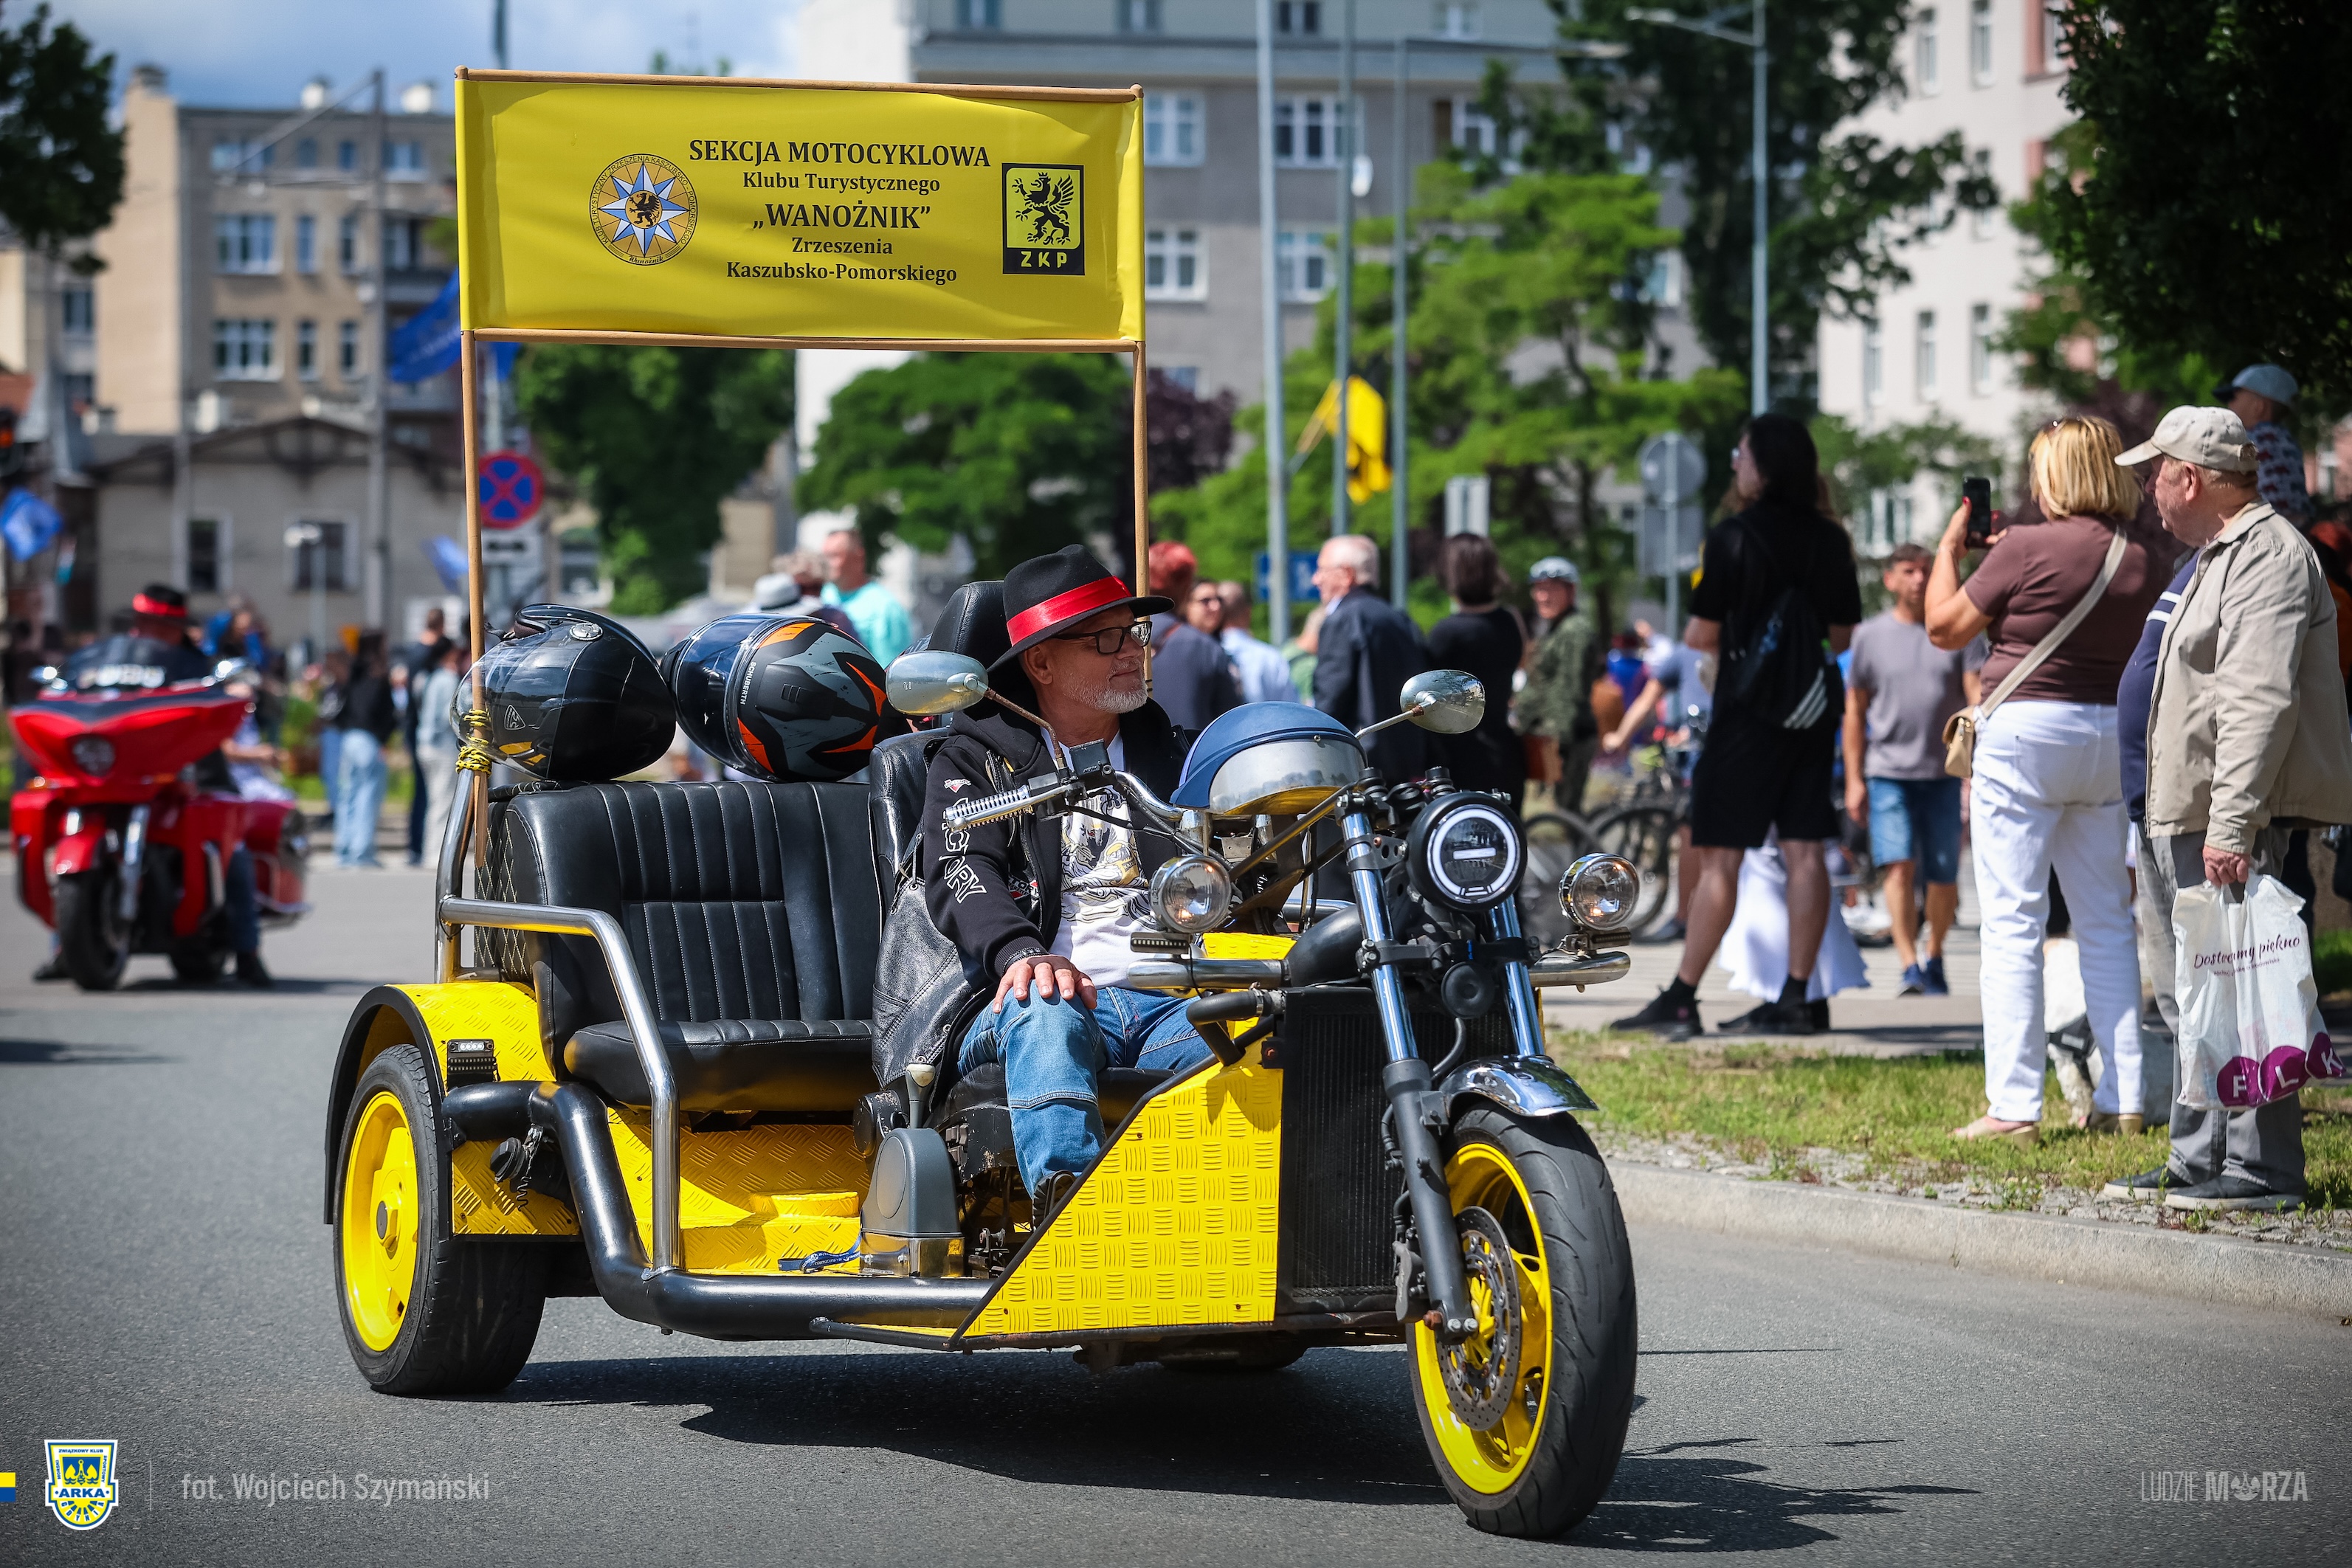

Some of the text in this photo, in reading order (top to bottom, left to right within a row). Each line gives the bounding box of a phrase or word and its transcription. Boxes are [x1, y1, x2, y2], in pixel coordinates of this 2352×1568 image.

[608, 156, 649, 174] ZRZESZENIA
[689, 139, 991, 167] SEKCJA MOTOCYKLOWA
[743, 172, 940, 196] Klubu Turystycznego
[591, 173, 610, 225] TURYSTYCZNY
[753, 200, 931, 229] „WANOŻNIK”
[596, 227, 609, 244] KLUB
[792, 237, 893, 255] Zrzeszenia
[1021, 251, 1067, 268] ZKP
[726, 261, 957, 286] Kaszubsko-Pomorskiego
[739, 661, 757, 705] SCHUBERTH
[2259, 933, 2300, 960] piękno
